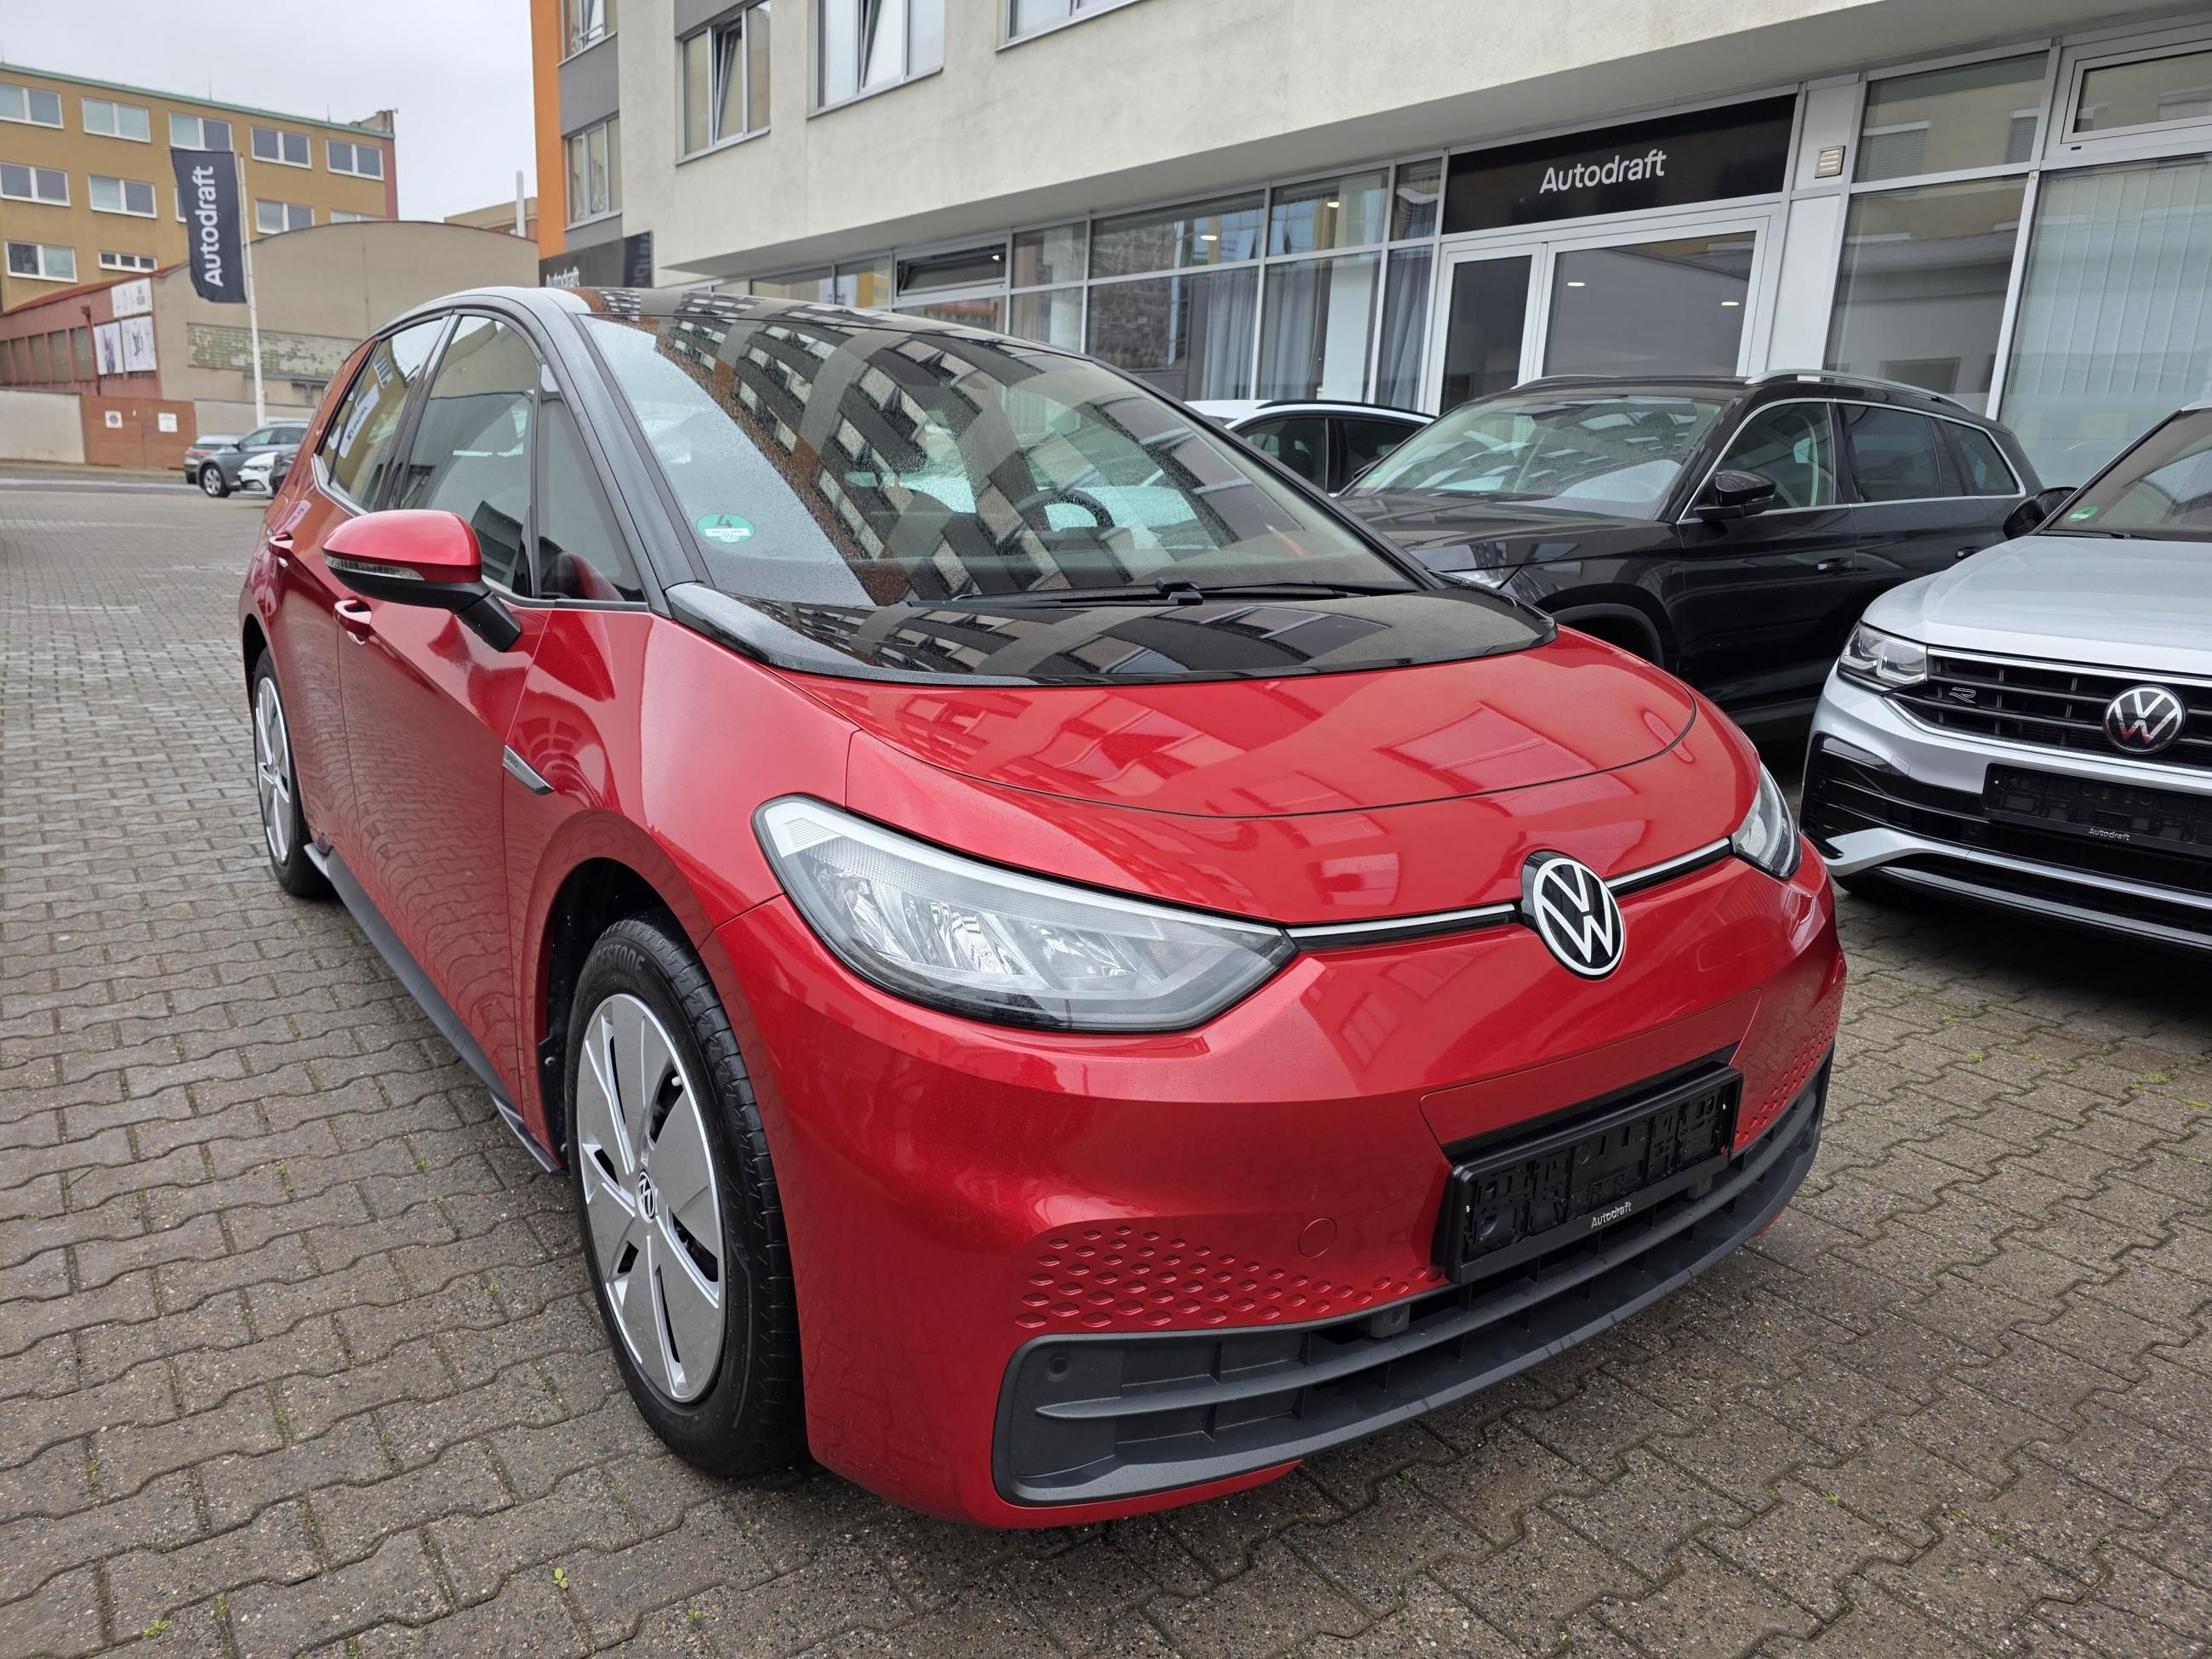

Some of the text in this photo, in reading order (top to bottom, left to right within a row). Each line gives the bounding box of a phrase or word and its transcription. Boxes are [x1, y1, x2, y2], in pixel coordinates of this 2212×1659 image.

[1539, 149, 1667, 194] Autodraft
[191, 165, 224, 288] Autodraft
[717, 515, 733, 527] 4
[2089, 828, 2130, 841] Autodraft
[1590, 1201, 1632, 1229] Autodraft
